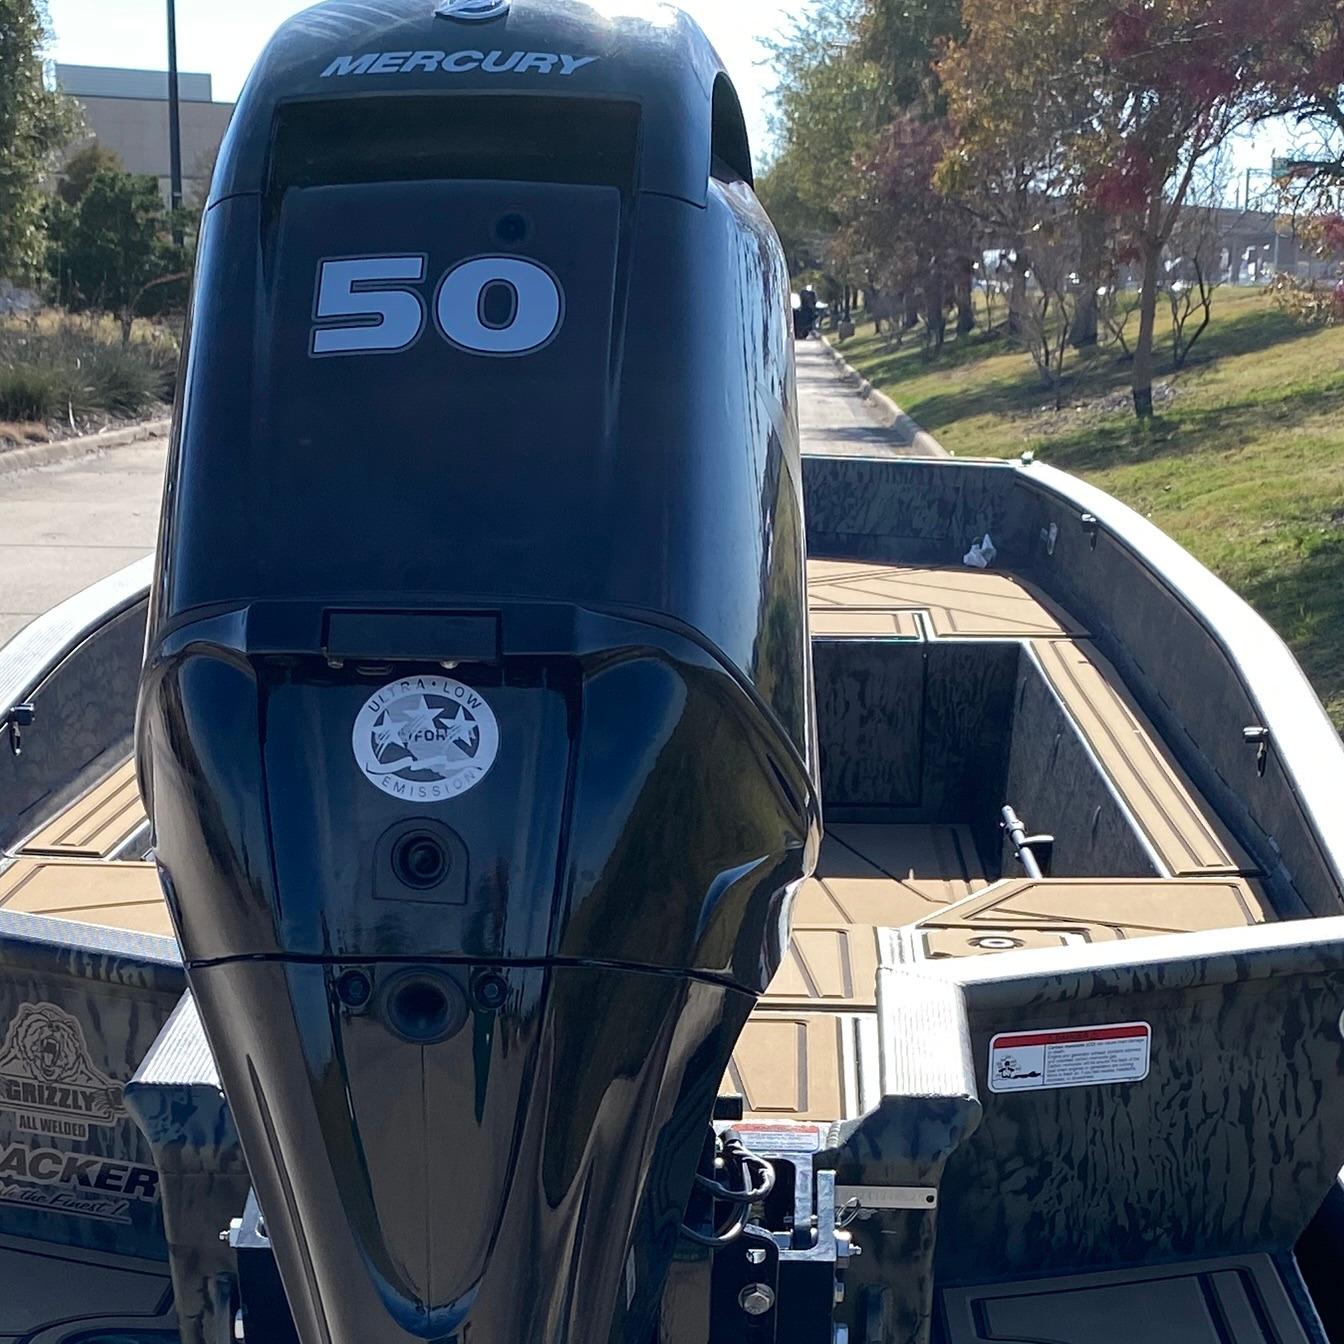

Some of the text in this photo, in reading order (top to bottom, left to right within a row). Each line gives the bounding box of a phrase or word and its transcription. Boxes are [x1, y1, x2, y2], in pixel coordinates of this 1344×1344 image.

[320, 48, 601, 77] MERCURY
[308, 251, 566, 359] 50
[367, 678, 483, 713] ULTRA LOW
[381, 770, 475, 798] EMISSION
[7, 1081, 96, 1112] GRIZZLY
[19, 1115, 87, 1138] ALL WELDED
[20, 1189, 47, 1203] the
